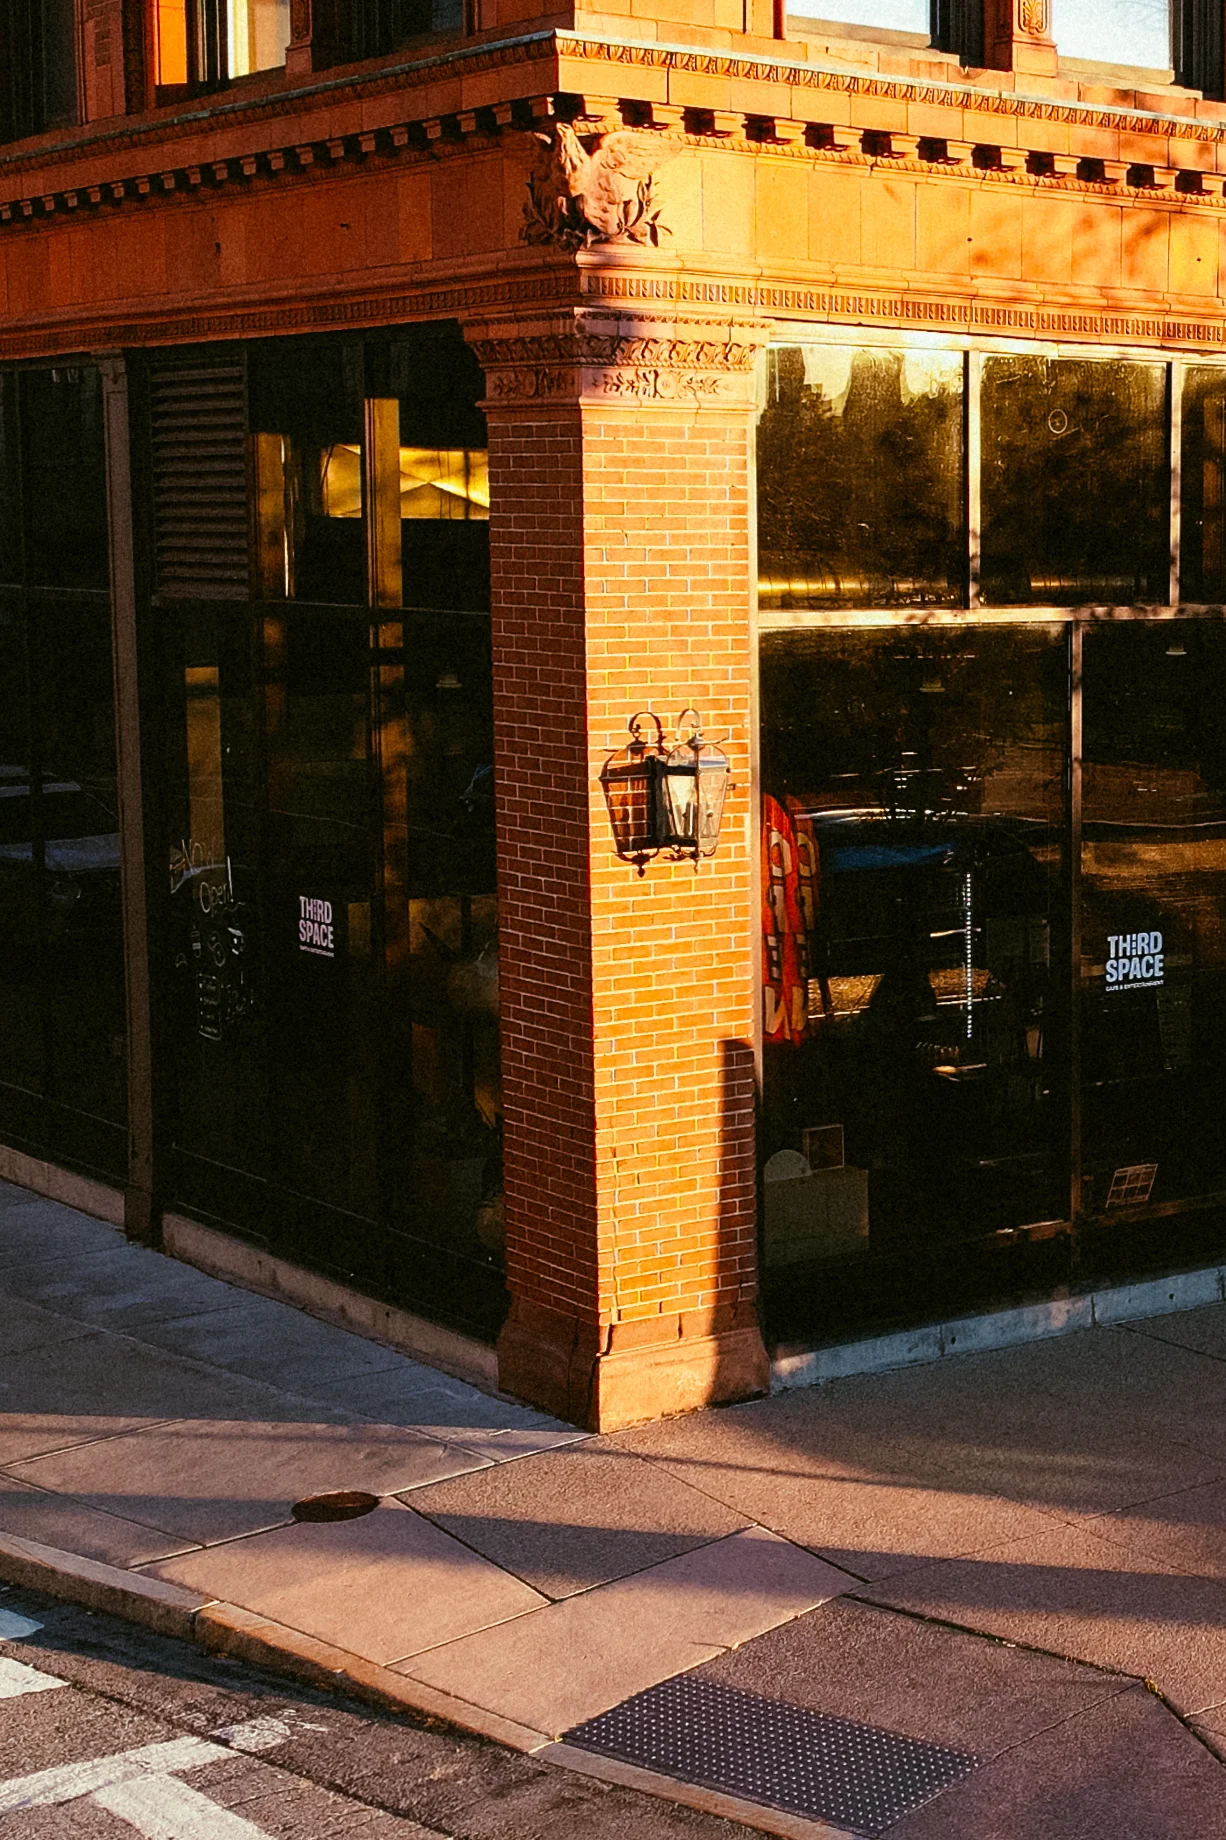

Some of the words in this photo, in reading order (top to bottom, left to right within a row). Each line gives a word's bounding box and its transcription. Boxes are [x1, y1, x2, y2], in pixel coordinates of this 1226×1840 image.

[299, 895, 333, 924] THIRD
[299, 919, 335, 949] SPACE
[1107, 931, 1163, 958] THIRD
[1105, 955, 1165, 983] SPACE
